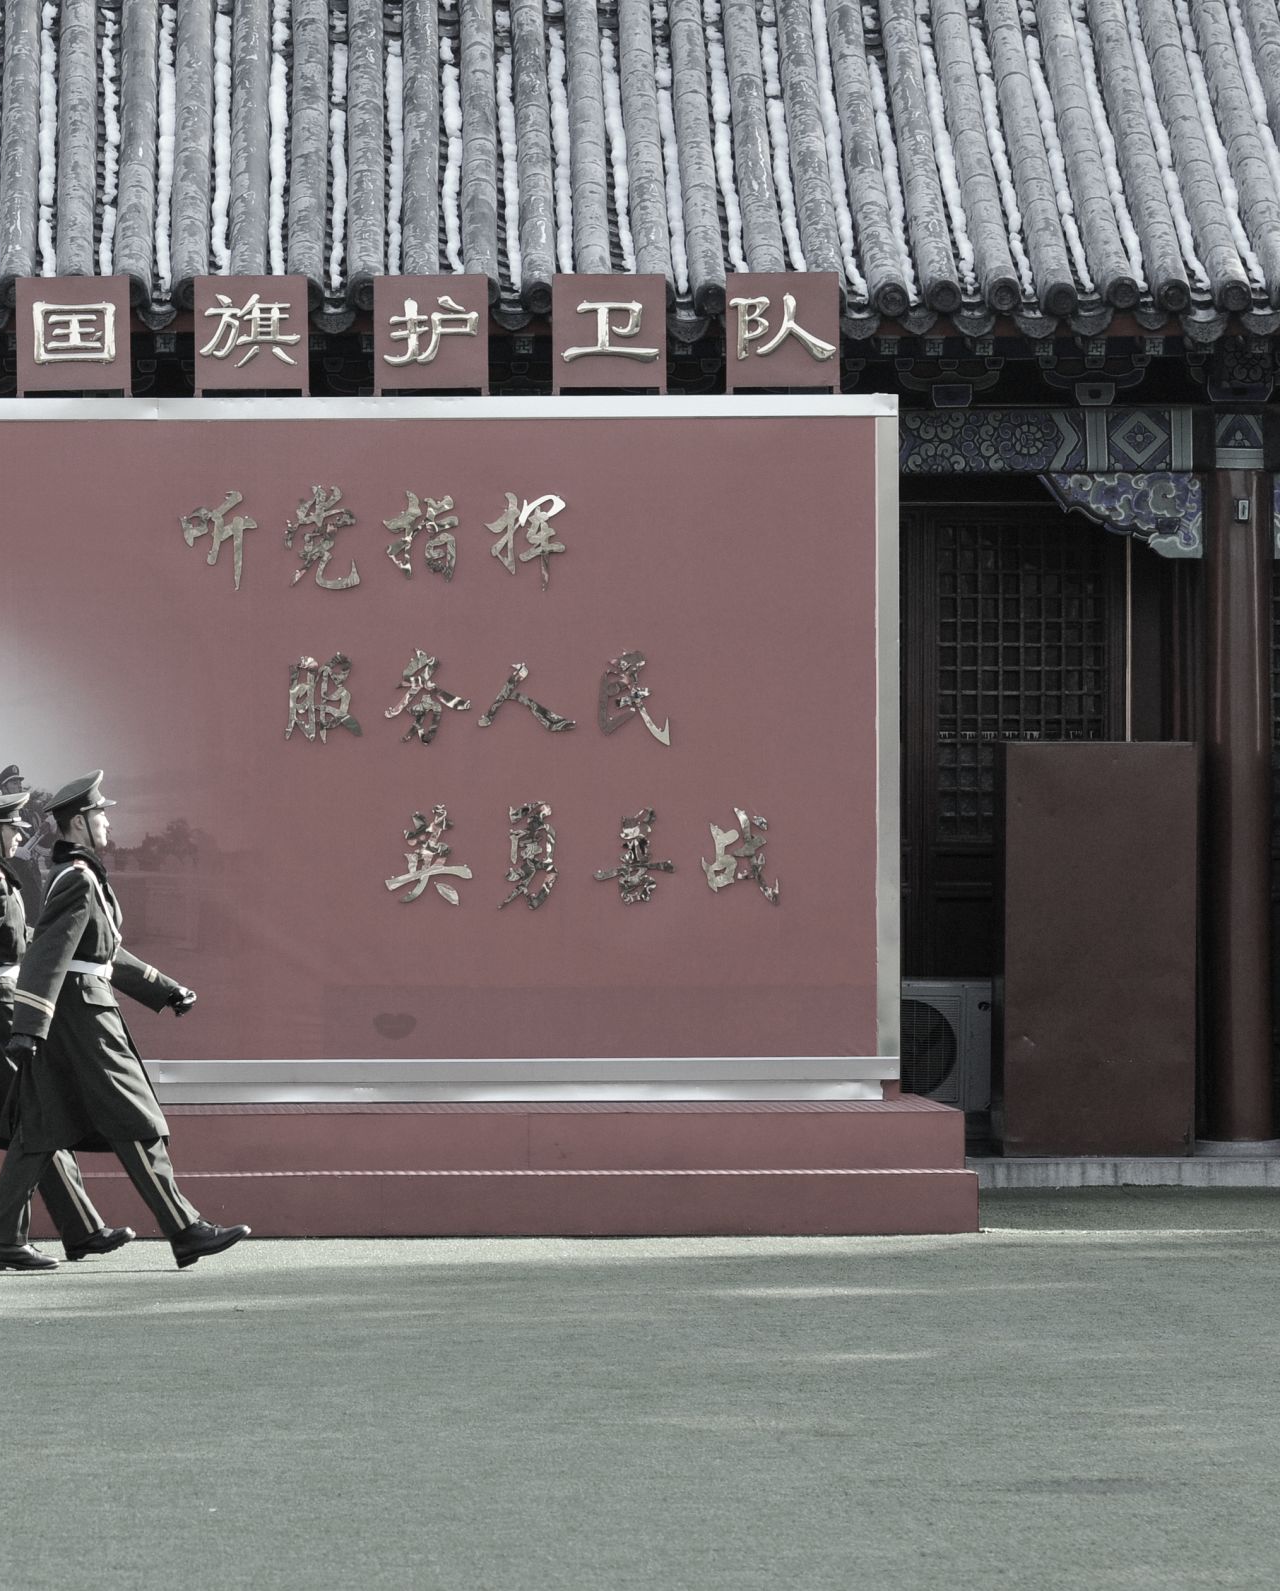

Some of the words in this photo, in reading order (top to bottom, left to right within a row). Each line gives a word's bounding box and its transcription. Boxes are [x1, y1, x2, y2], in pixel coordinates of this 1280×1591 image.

[179, 484, 566, 591] 听党指挥
[284, 648, 672, 746] 服务人民
[385, 801, 780, 911] 英勇善战
